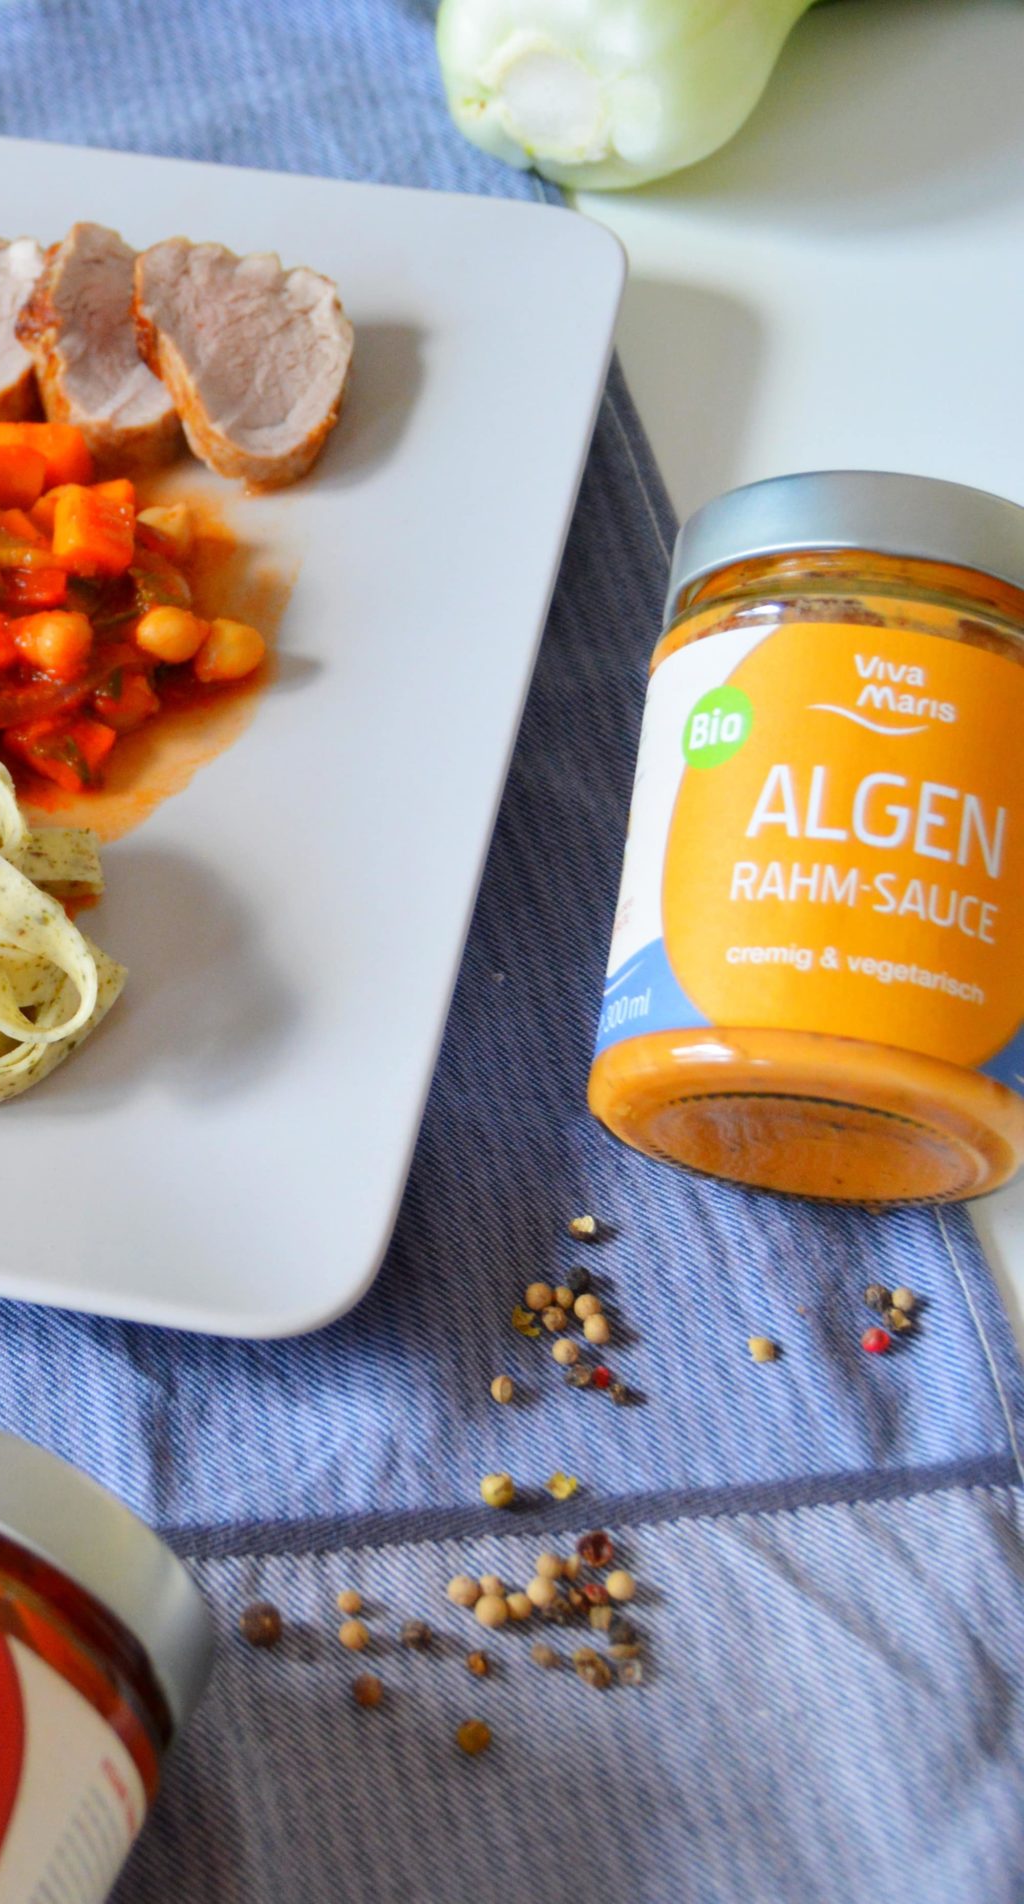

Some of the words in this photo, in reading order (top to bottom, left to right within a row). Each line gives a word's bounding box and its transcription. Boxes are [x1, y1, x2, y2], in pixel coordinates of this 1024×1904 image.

[854, 653, 925, 687] Viva
[689, 707, 743, 750] Bio
[856, 685, 957, 722] Maris
[745, 764, 1005, 879] ALGEN
[729, 861, 999, 944] RAHM-SAUCE
[726, 943, 813, 970] cremig
[820, 946, 840, 969] &
[847, 954, 984, 1005] vegetarisch
